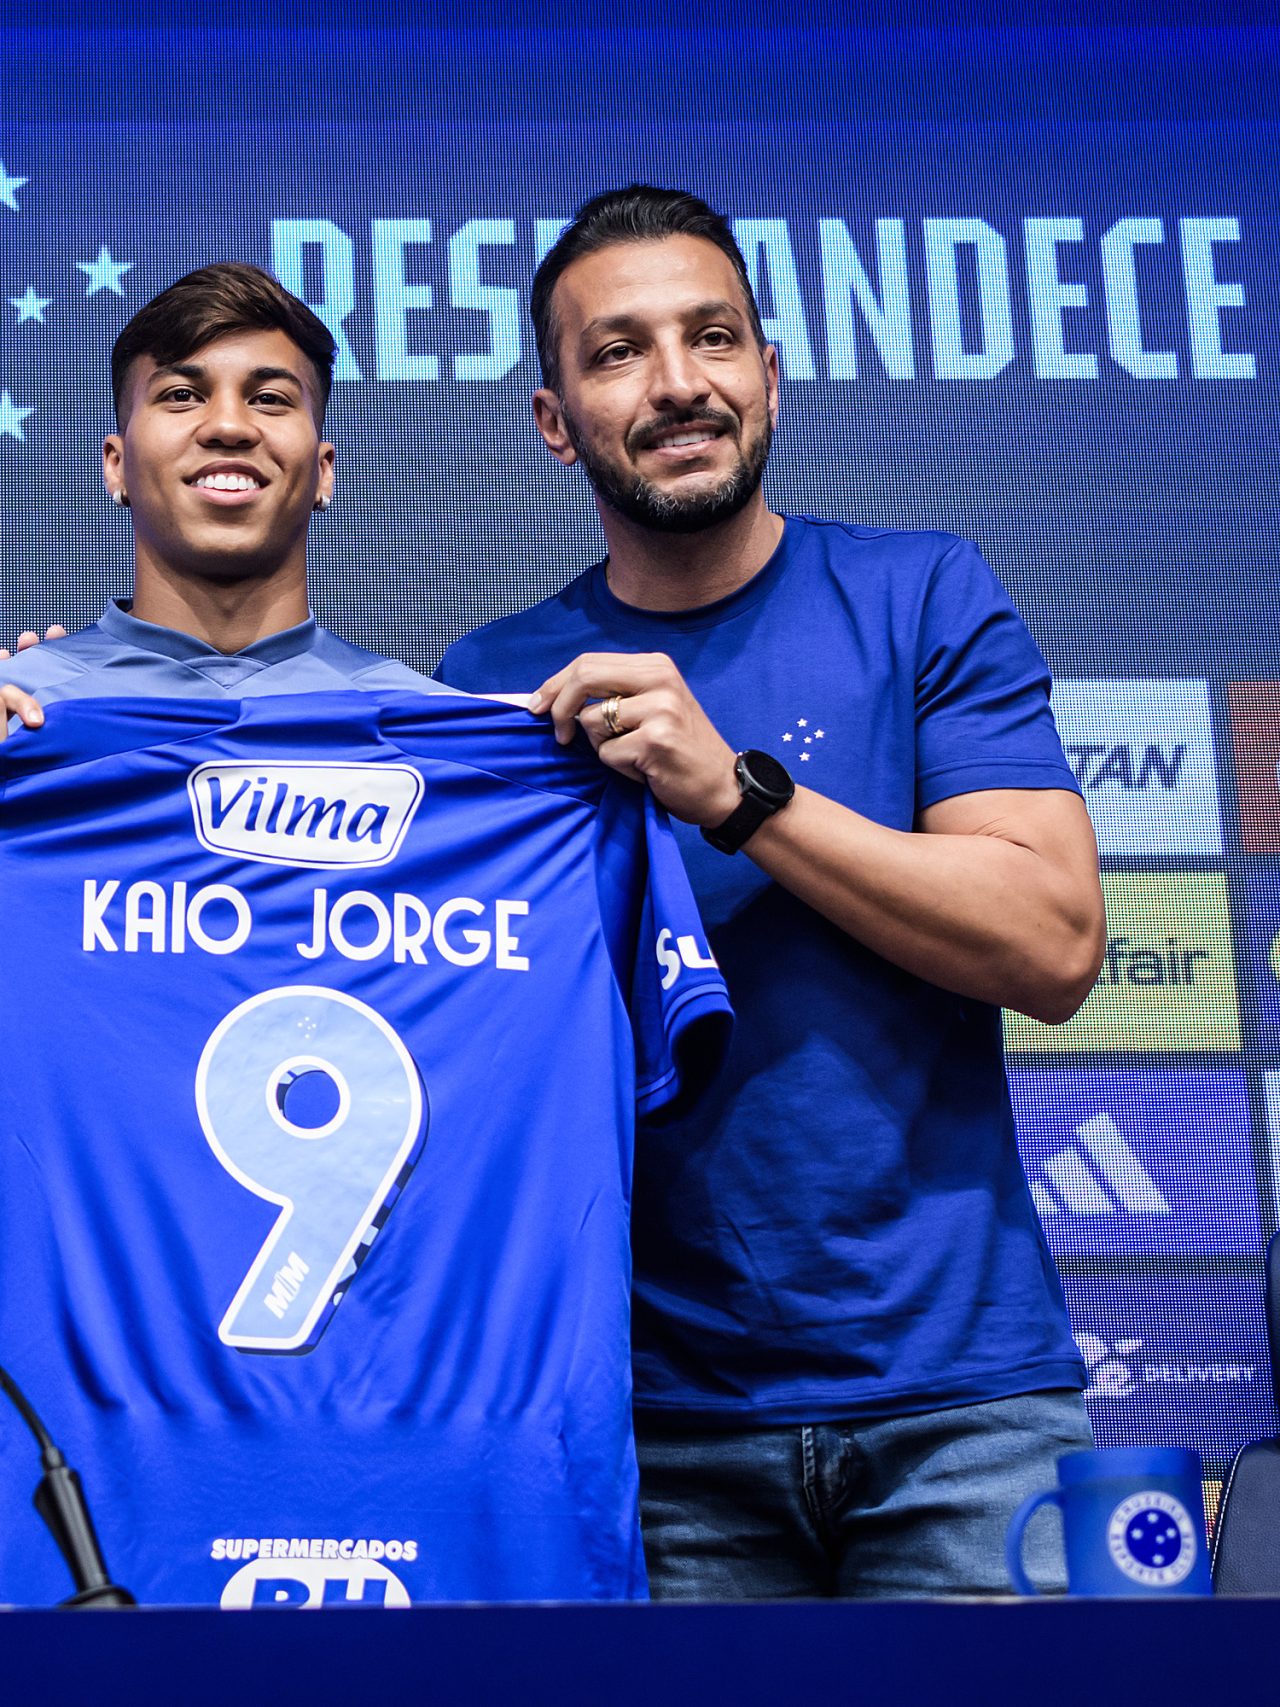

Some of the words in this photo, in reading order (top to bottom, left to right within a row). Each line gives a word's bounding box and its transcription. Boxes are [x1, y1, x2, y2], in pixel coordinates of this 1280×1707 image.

[272, 217, 1257, 382] RESANDECE
[206, 776, 390, 844] Vilma
[81, 879, 252, 955] KAIO
[296, 887, 530, 971] JORGE
[1097, 936, 1208, 986] fair
[195, 985, 426, 1354] 9
[210, 1538, 418, 1562] SUPERMERCADOS
